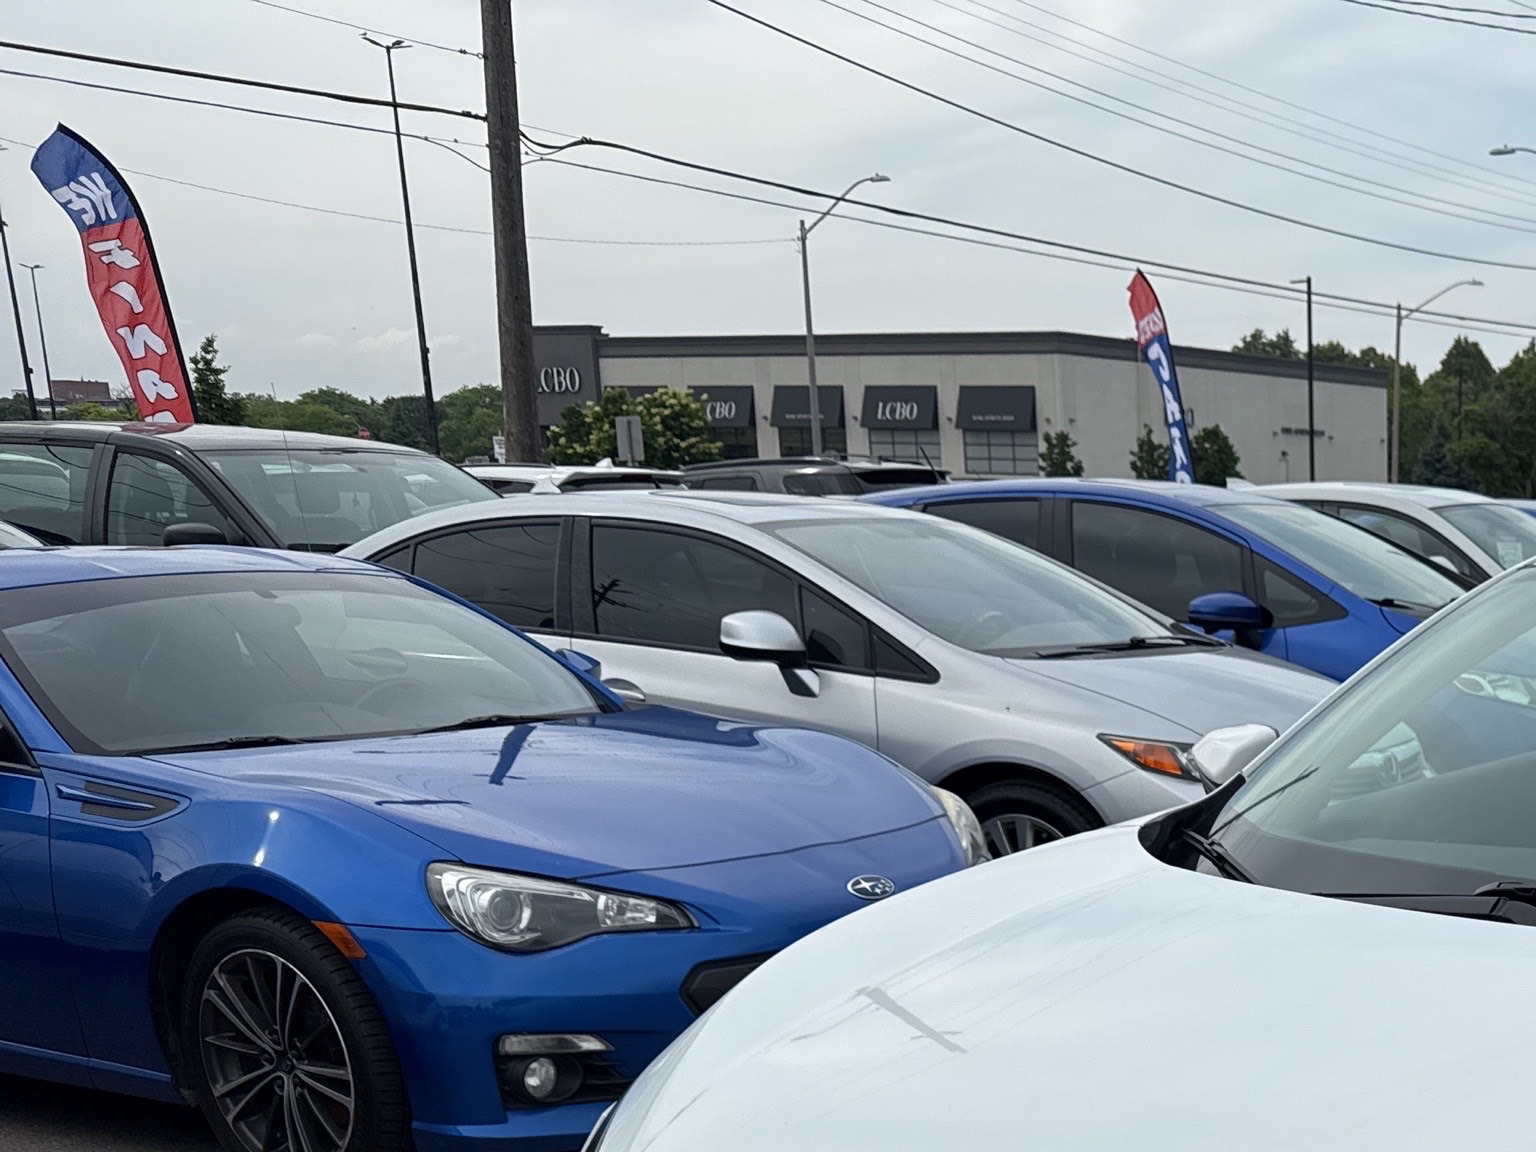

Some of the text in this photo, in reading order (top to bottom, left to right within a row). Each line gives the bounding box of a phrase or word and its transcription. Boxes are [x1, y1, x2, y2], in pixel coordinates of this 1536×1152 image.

[537, 366, 580, 393] CBO
[706, 401, 736, 419] CBO
[877, 401, 918, 420] LCBO
